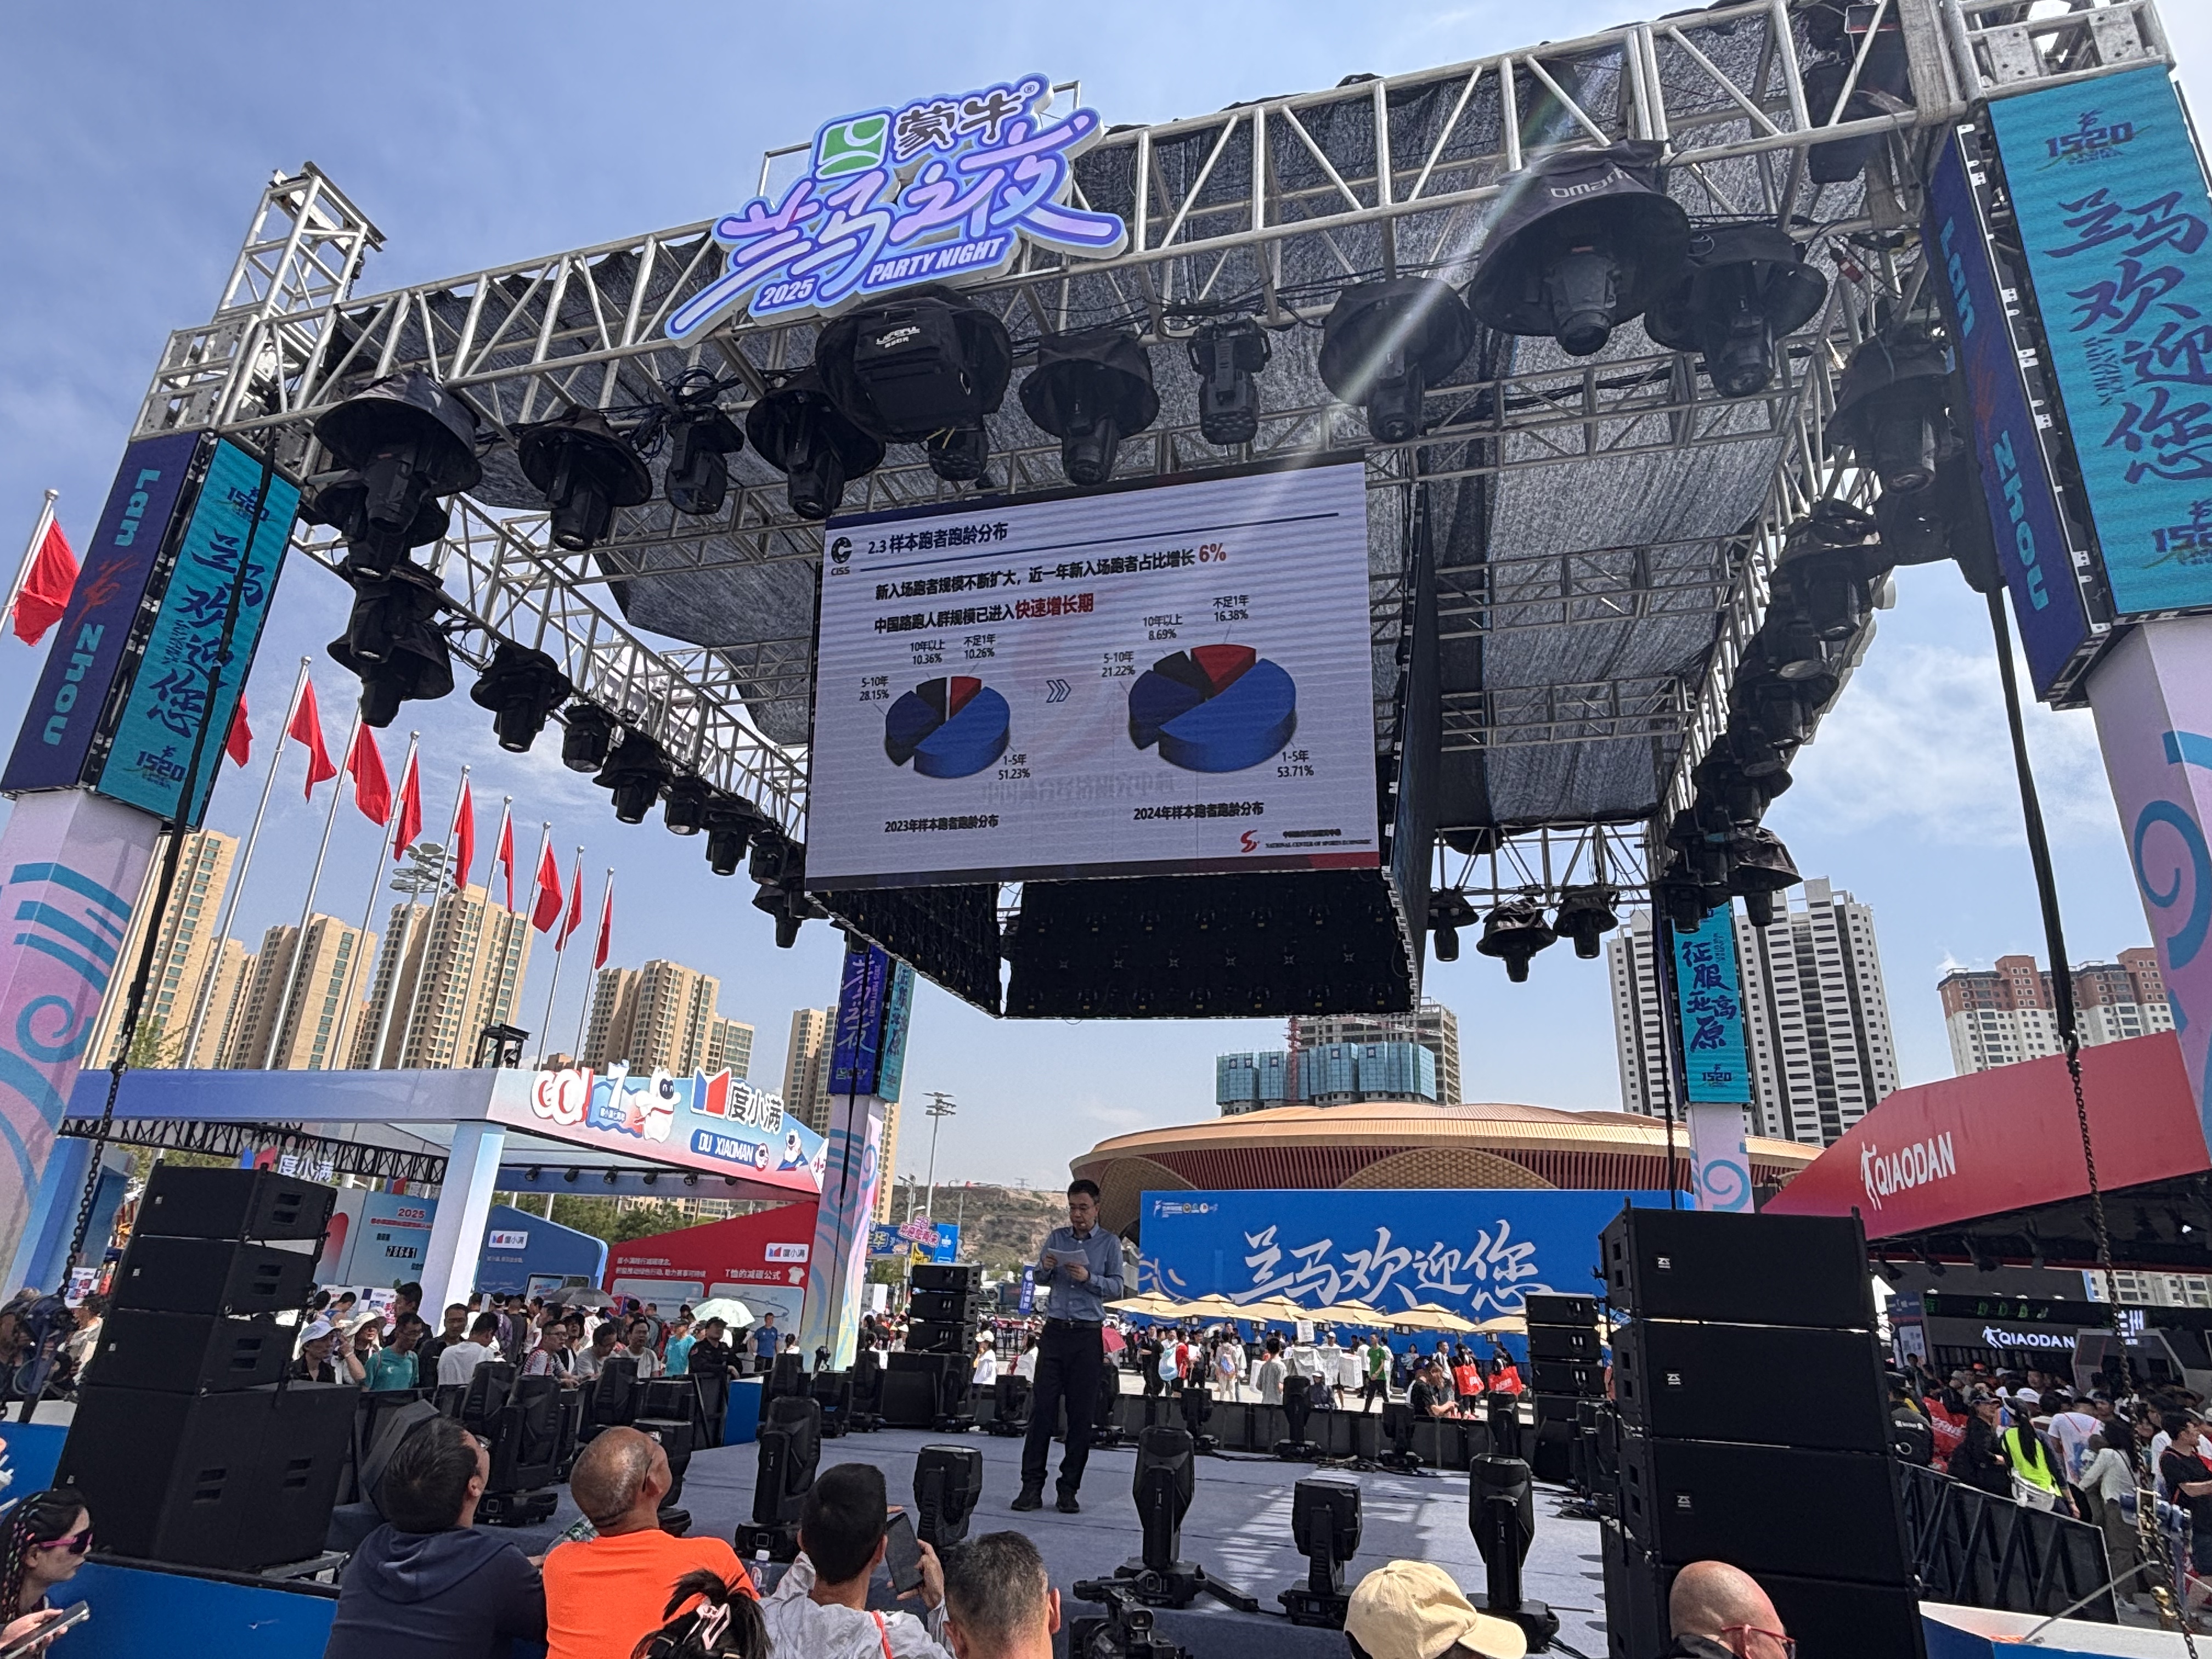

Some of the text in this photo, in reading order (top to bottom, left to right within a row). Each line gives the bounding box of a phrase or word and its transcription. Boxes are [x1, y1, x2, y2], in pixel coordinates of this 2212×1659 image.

[2045, 121, 2134, 157] 1520
[867, 236, 1007, 285] PARTY NIGHT
[759, 278, 815, 307] 2025
[868, 522, 1008, 555] 2.3 样本跑者跑龄分布
[1199, 543, 1227, 562] 6%
[831, 566, 850, 576] CISS
[1212, 594, 1249, 608] 不足1年
[1143, 614, 1183, 627] 10年以上
[1214, 609, 1249, 622] 16.38%
[964, 634, 996, 647] 不足1年
[1148, 628, 1177, 641] 8.69%
[910, 640, 946, 652] 10年以上
[912, 653, 943, 665] 10.36%
[964, 647, 995, 659] 10.26%
[1103, 651, 1135, 663] 5-10年
[1101, 665, 1136, 678] 21.22%
[861, 676, 889, 688] 5-10年
[859, 689, 890, 701] 28.15%
[1003, 753, 1027, 766] 1-5年
[1282, 750, 1310, 763] 1-5年
[998, 769, 1031, 780] 51.23%
[1277, 766, 1314, 778] 53.71%
[1702, 1071, 1733, 1083] 1520
[729, 1082, 783, 1134] 度小满
[698, 1132, 754, 1163] DU XIAOMAN
[277, 1154, 335, 1182] 度小满
[1874, 1131, 1956, 1197] QIAODAN
[397, 1207, 425, 1220] 2025
[1227, 1218, 1555, 1316] 兰马欢迎您
[1999, 1331, 2076, 1350] QIAODAN
